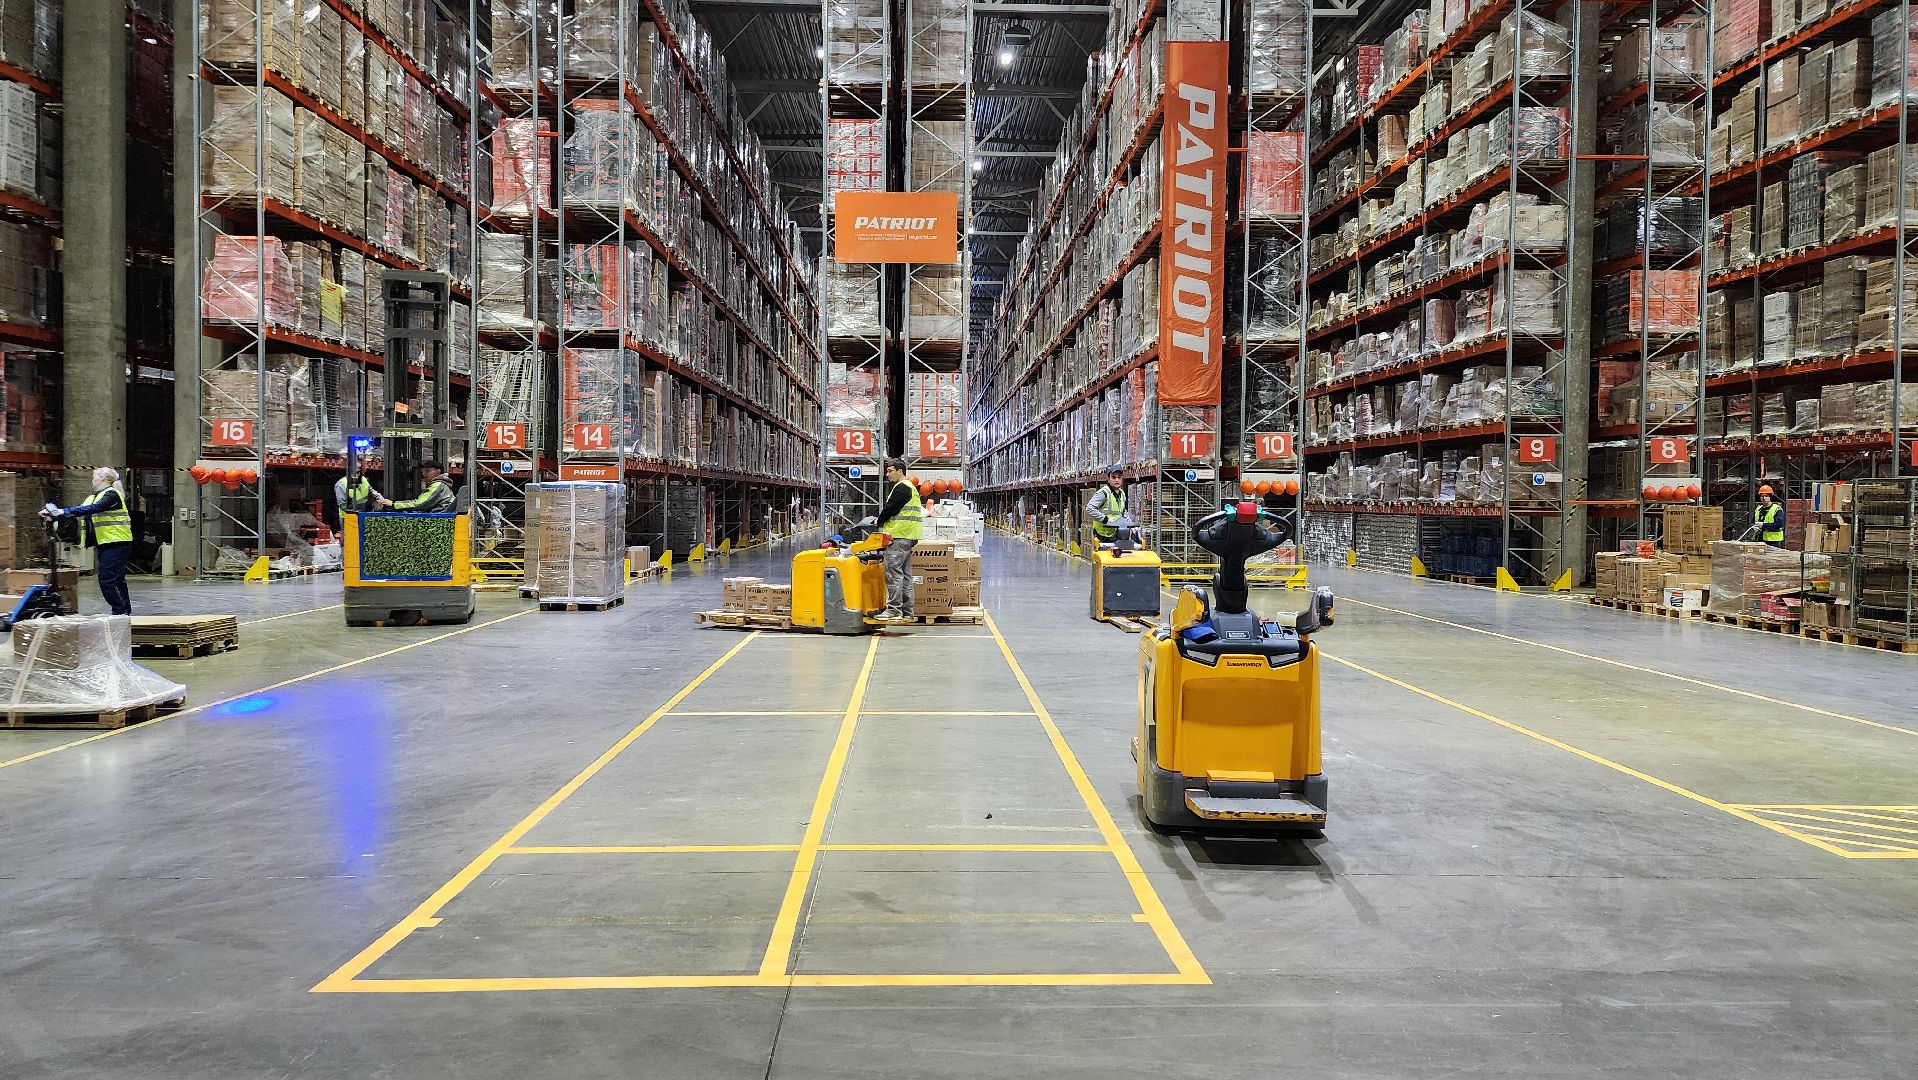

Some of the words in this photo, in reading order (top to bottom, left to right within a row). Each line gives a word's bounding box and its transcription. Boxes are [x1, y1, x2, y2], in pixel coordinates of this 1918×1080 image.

[854, 216, 938, 230] PATRIOT
[1172, 83, 1216, 364] PATRIOT
[220, 421, 245, 441] 16
[494, 425, 517, 445] 15
[581, 426, 603, 446] 14
[842, 431, 865, 450] 13
[926, 432, 948, 451] 12
[1180, 434, 1196, 454] 11
[1262, 435, 1285, 455] 10
[1530, 439, 1544, 458] 9
[1661, 440, 1677, 459] 8
